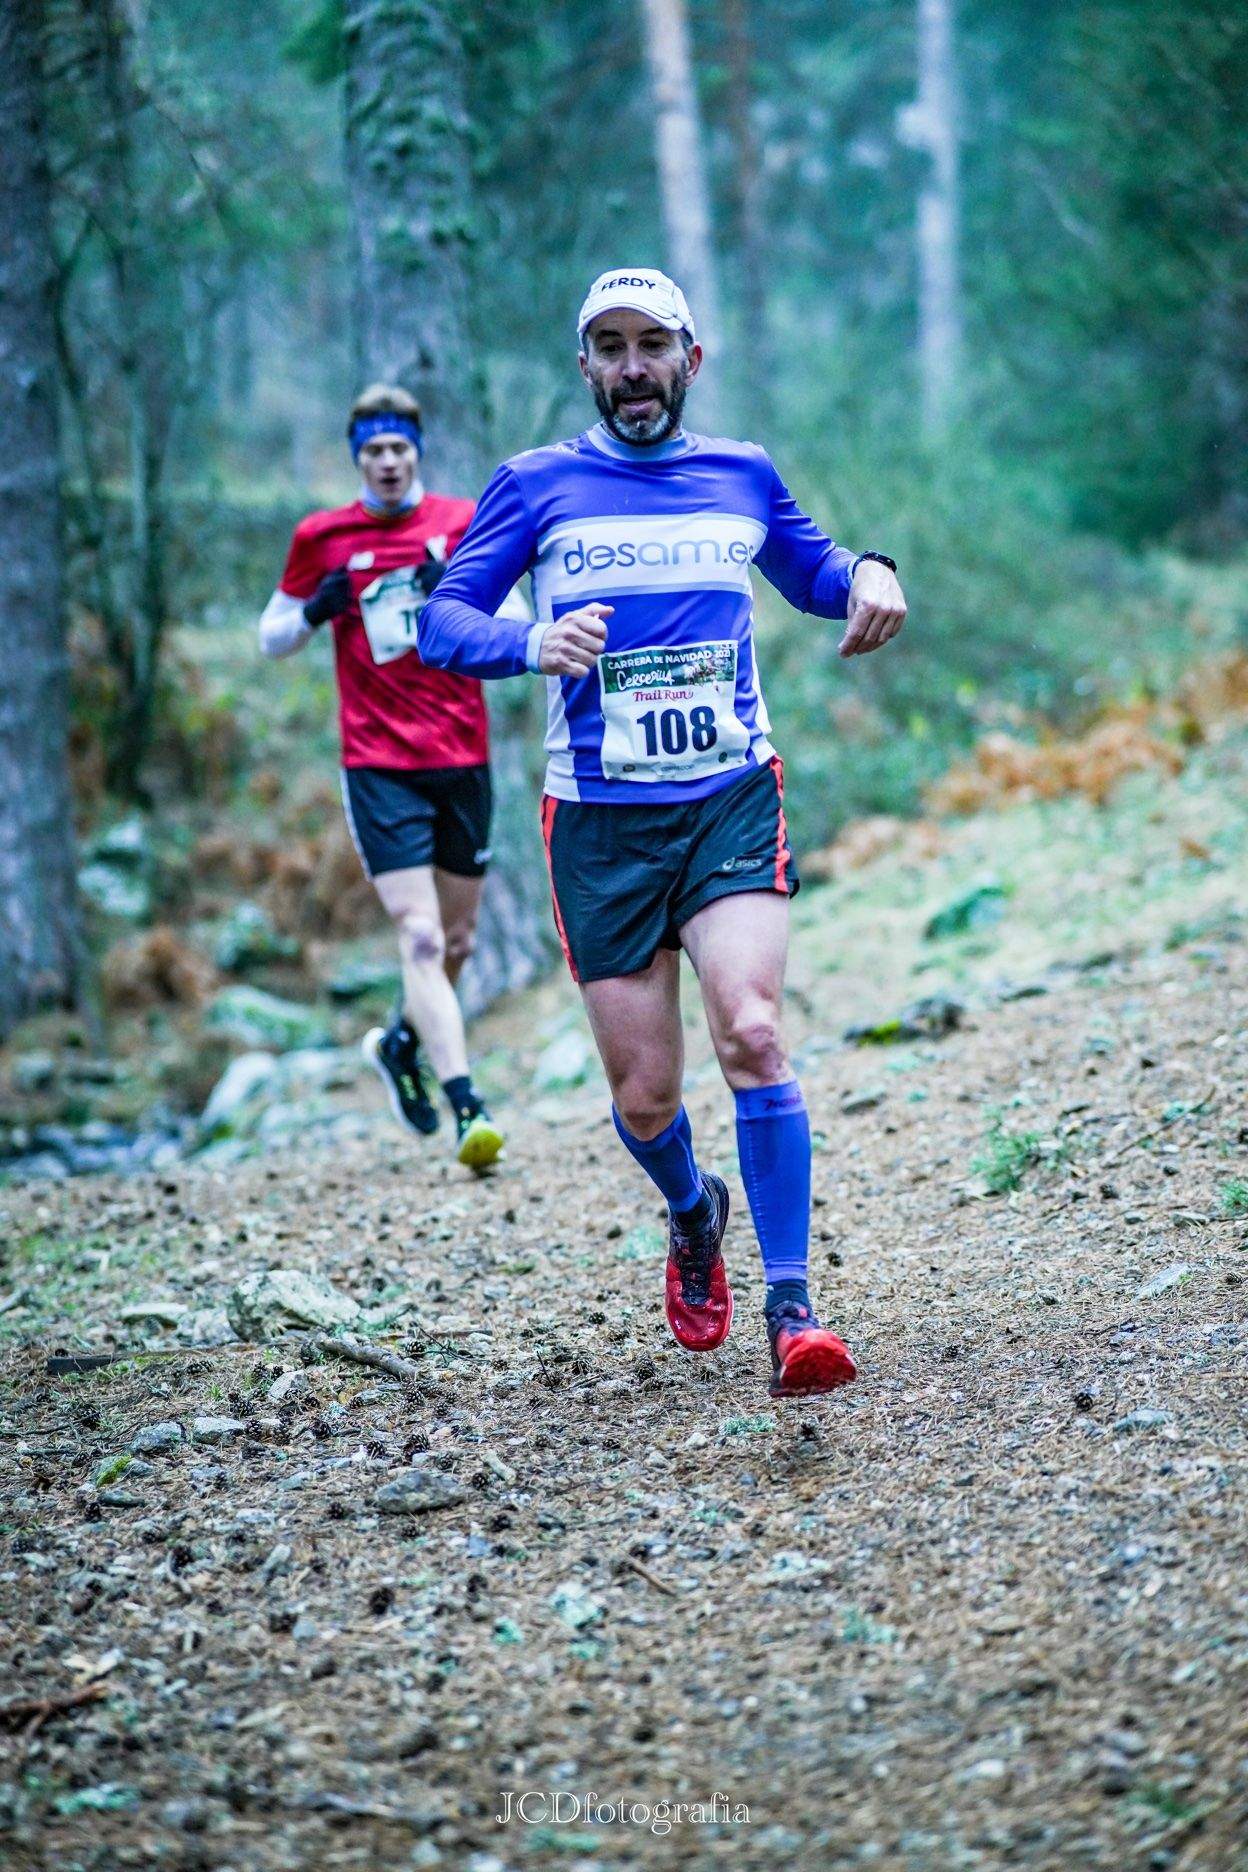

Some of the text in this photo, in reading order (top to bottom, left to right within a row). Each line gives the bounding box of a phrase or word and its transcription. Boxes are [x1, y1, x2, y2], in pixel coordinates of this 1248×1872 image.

[601, 277, 656, 292] FERDY
[607, 654, 652, 670] CARRERA
[665, 650, 712, 664] NAVIDAD
[633, 689, 661, 702] Trail
[636, 706, 717, 757] 108
